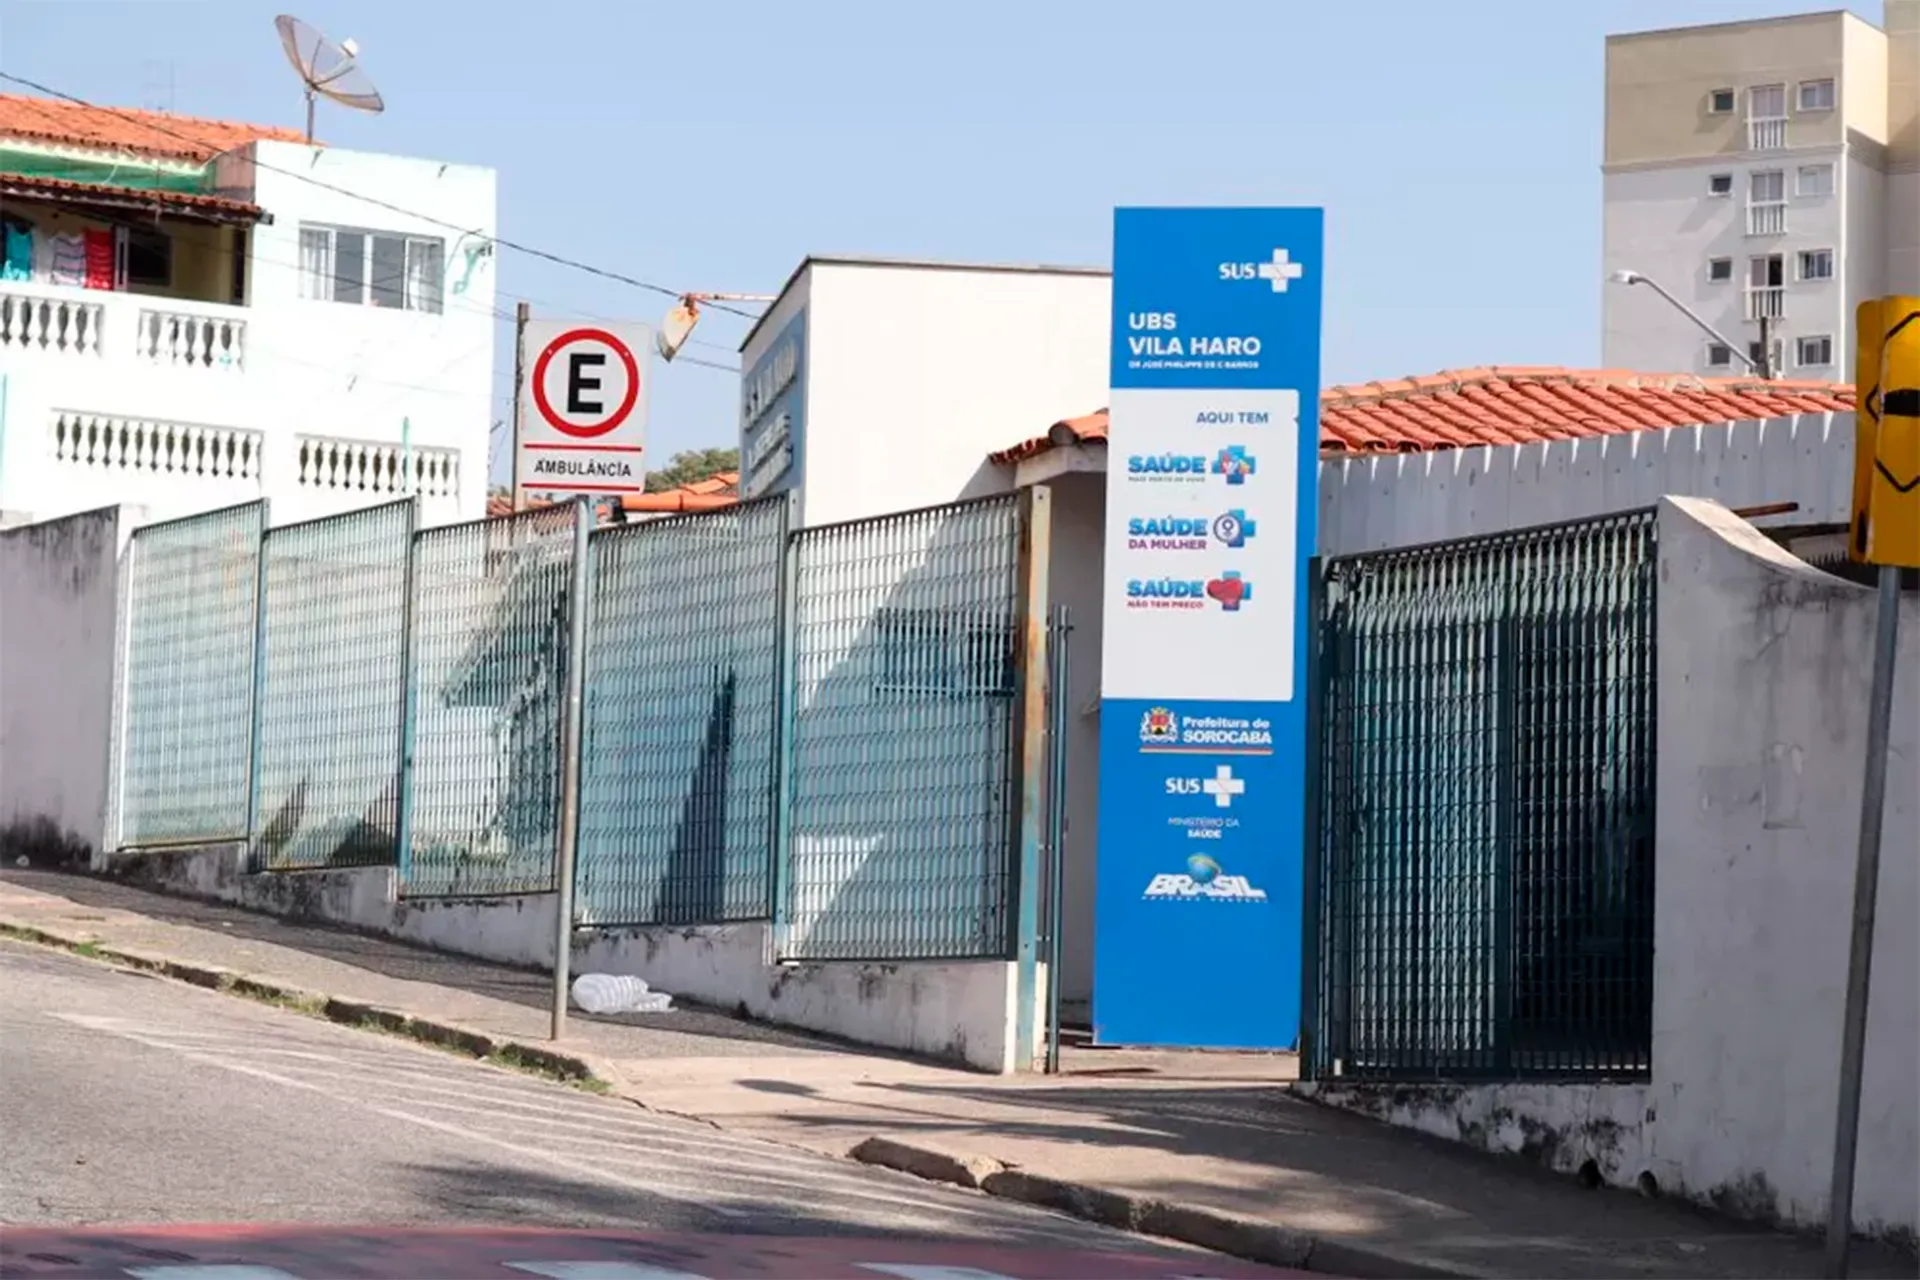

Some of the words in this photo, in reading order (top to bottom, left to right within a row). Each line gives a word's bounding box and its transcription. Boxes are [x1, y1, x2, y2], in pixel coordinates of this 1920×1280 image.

[1218, 262, 1256, 279] SUS
[1129, 312, 1176, 330] UBS
[1128, 336, 1184, 355] VILA
[1190, 336, 1261, 355] HARO
[568, 353, 606, 414] E
[1196, 412, 1234, 424] AQUI
[1238, 412, 1269, 424] TEM
[534, 459, 631, 477] AMBULÂNCIA
[1128, 452, 1206, 474] SAÚDE
[1128, 515, 1208, 537] SAÚDE
[1128, 539, 1148, 549] DA
[1151, 539, 1207, 549] MULHER
[1127, 577, 1204, 598] SAÚDE
[1127, 600, 1148, 608] NÃO
[1182, 716, 1249, 728] Prefeitura
[1252, 718, 1270, 729] de
[1182, 731, 1272, 744] SOROCABA
[1165, 777, 1200, 794] SUS
[1144, 873, 1267, 897] BRASIL
